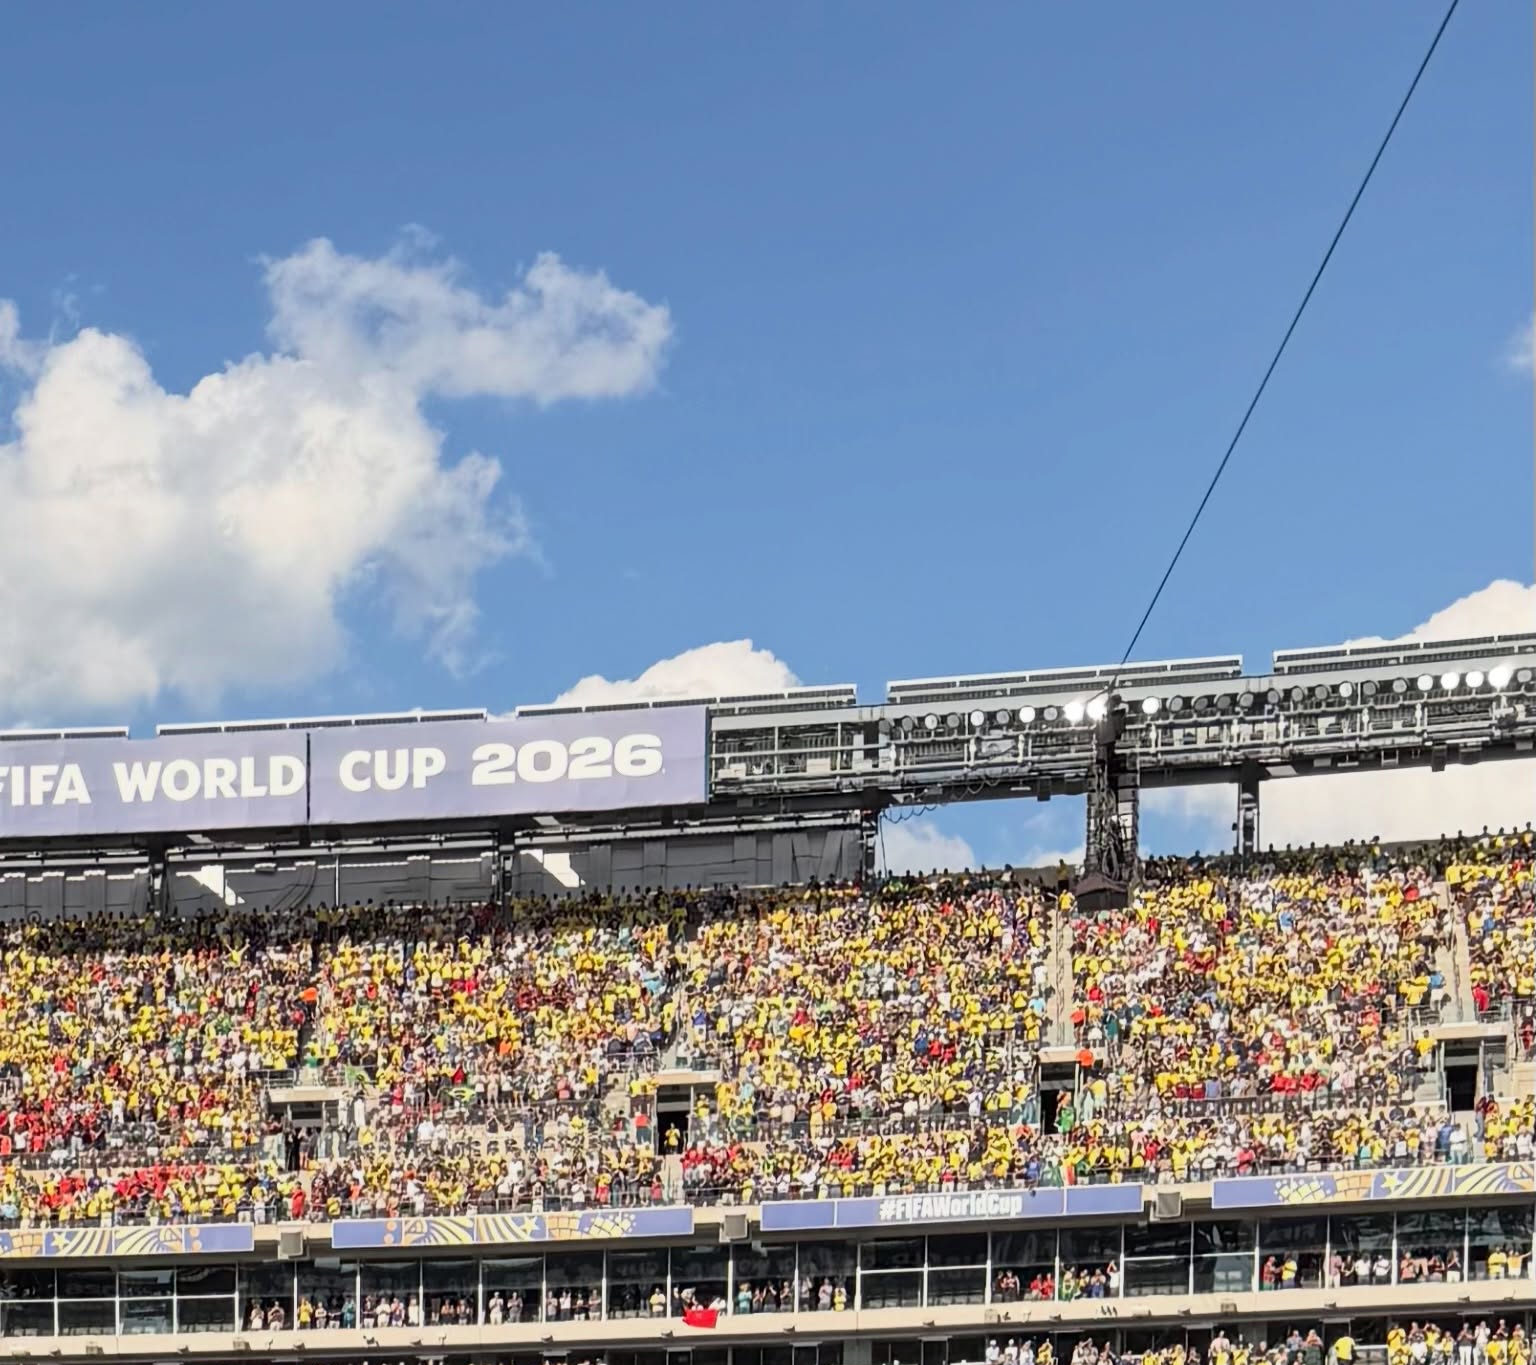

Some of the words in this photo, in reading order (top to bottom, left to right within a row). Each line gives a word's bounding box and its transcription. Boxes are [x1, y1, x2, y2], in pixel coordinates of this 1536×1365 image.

[113, 753, 307, 803] WORLD
[339, 747, 447, 793] CUP
[471, 733, 665, 786] 2026
